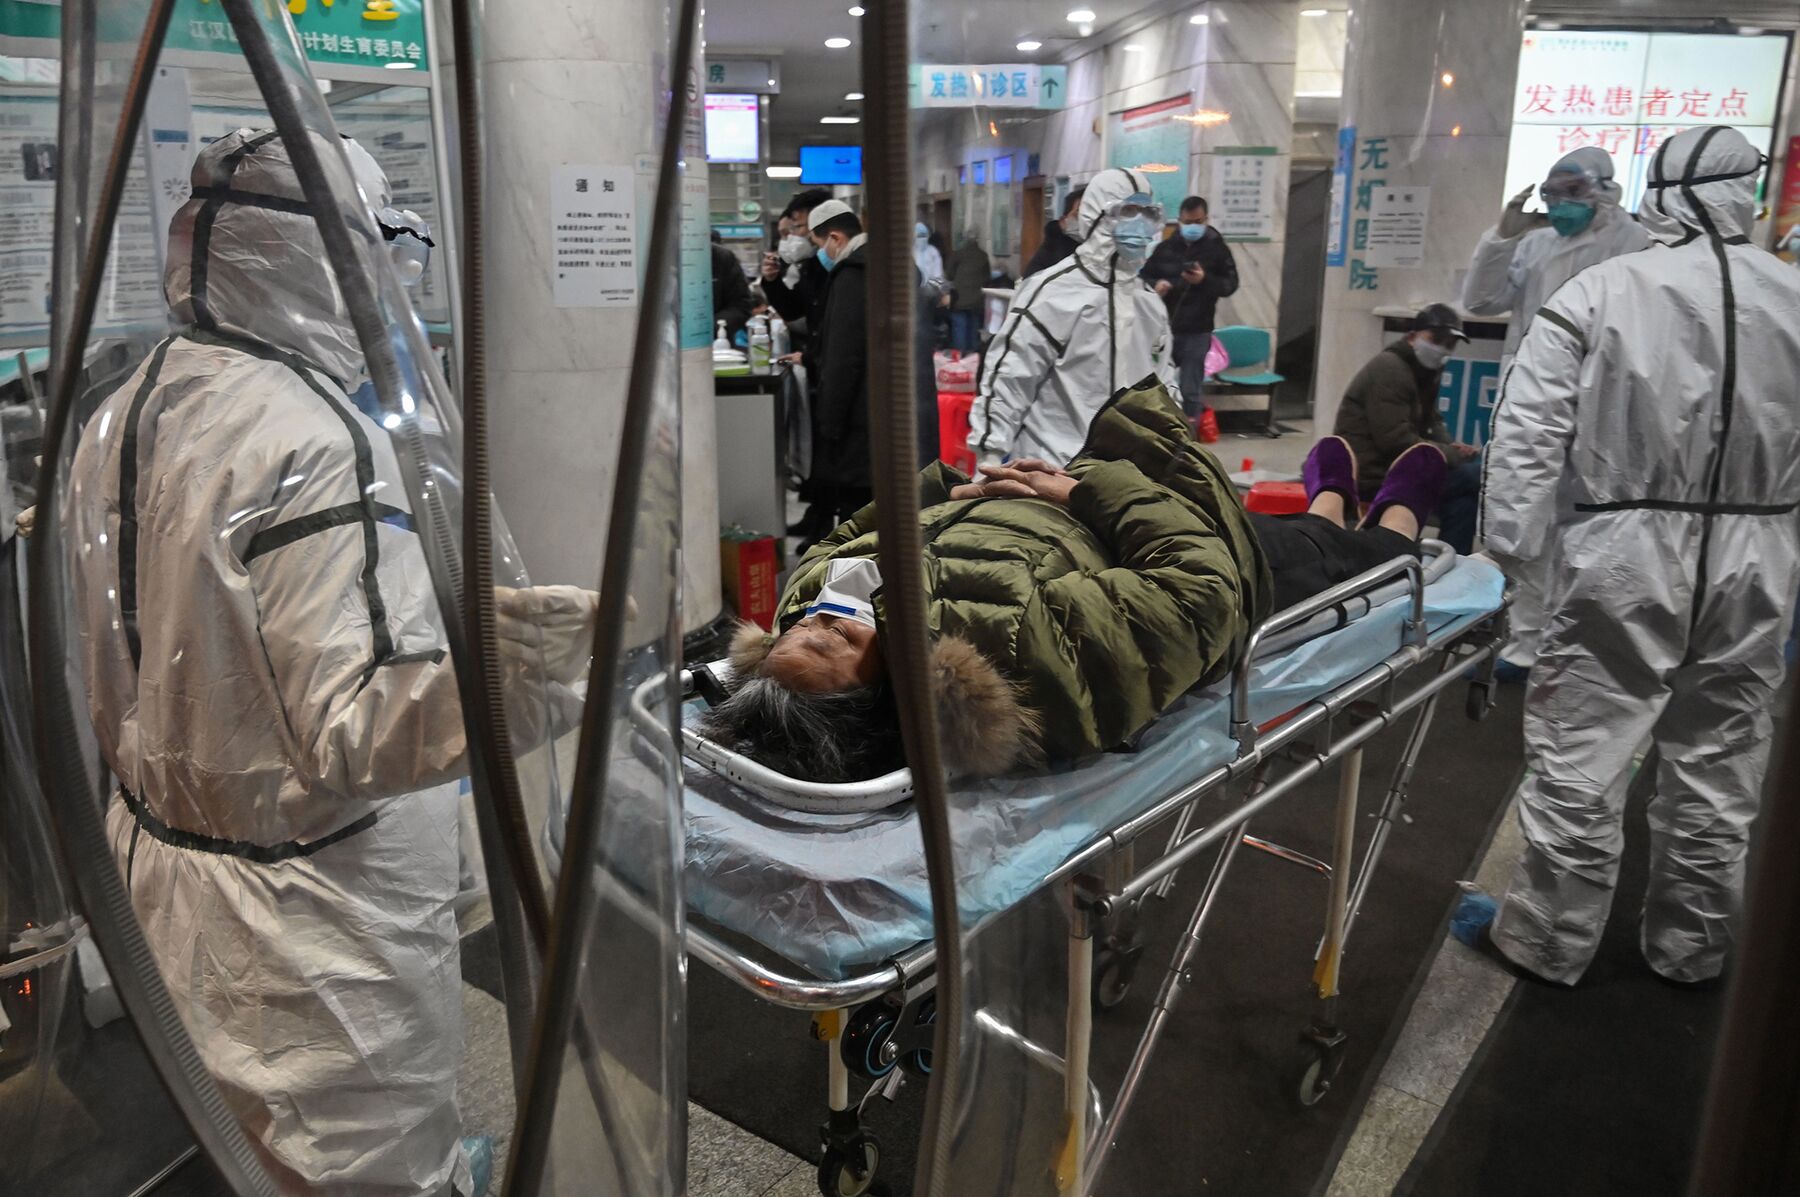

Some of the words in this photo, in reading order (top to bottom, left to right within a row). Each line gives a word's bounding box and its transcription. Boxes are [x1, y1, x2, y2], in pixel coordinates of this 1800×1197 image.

[930, 72, 1028, 98] 发热门诊区
[1521, 83, 1750, 117] 发热患者定点
[1557, 125, 1688, 156] 诊疗医
[575, 178, 615, 193] 通知
